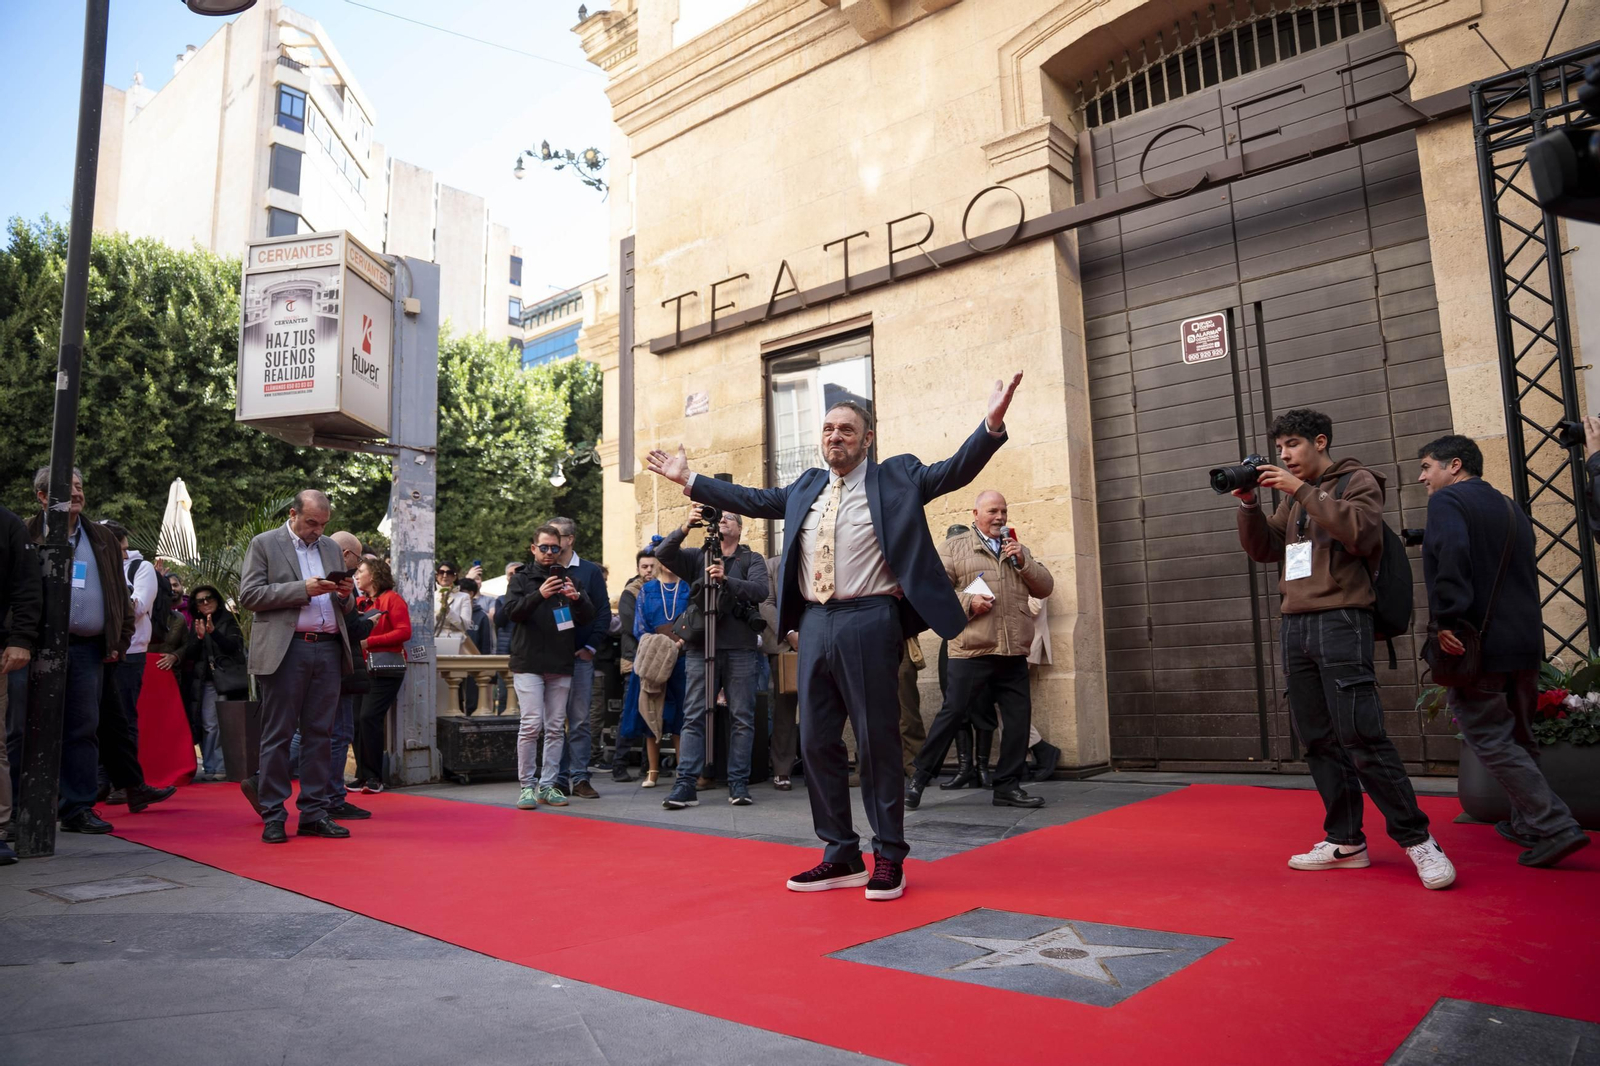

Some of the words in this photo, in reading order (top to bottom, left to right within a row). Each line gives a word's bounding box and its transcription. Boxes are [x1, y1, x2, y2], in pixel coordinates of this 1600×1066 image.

[258, 243, 333, 263] CERVANTES
[349, 248, 388, 287] CERVANTES
[661, 185, 1025, 349] TEATRO
[274, 317, 308, 326] CERVANTES
[266, 332, 289, 349] HAZ
[293, 329, 316, 346] TUS
[1195, 329, 1219, 338] ALARMA
[265, 345, 315, 368] SUEÑOS
[352, 347, 379, 382] kuver
[264, 365, 315, 383] REALIDAD
